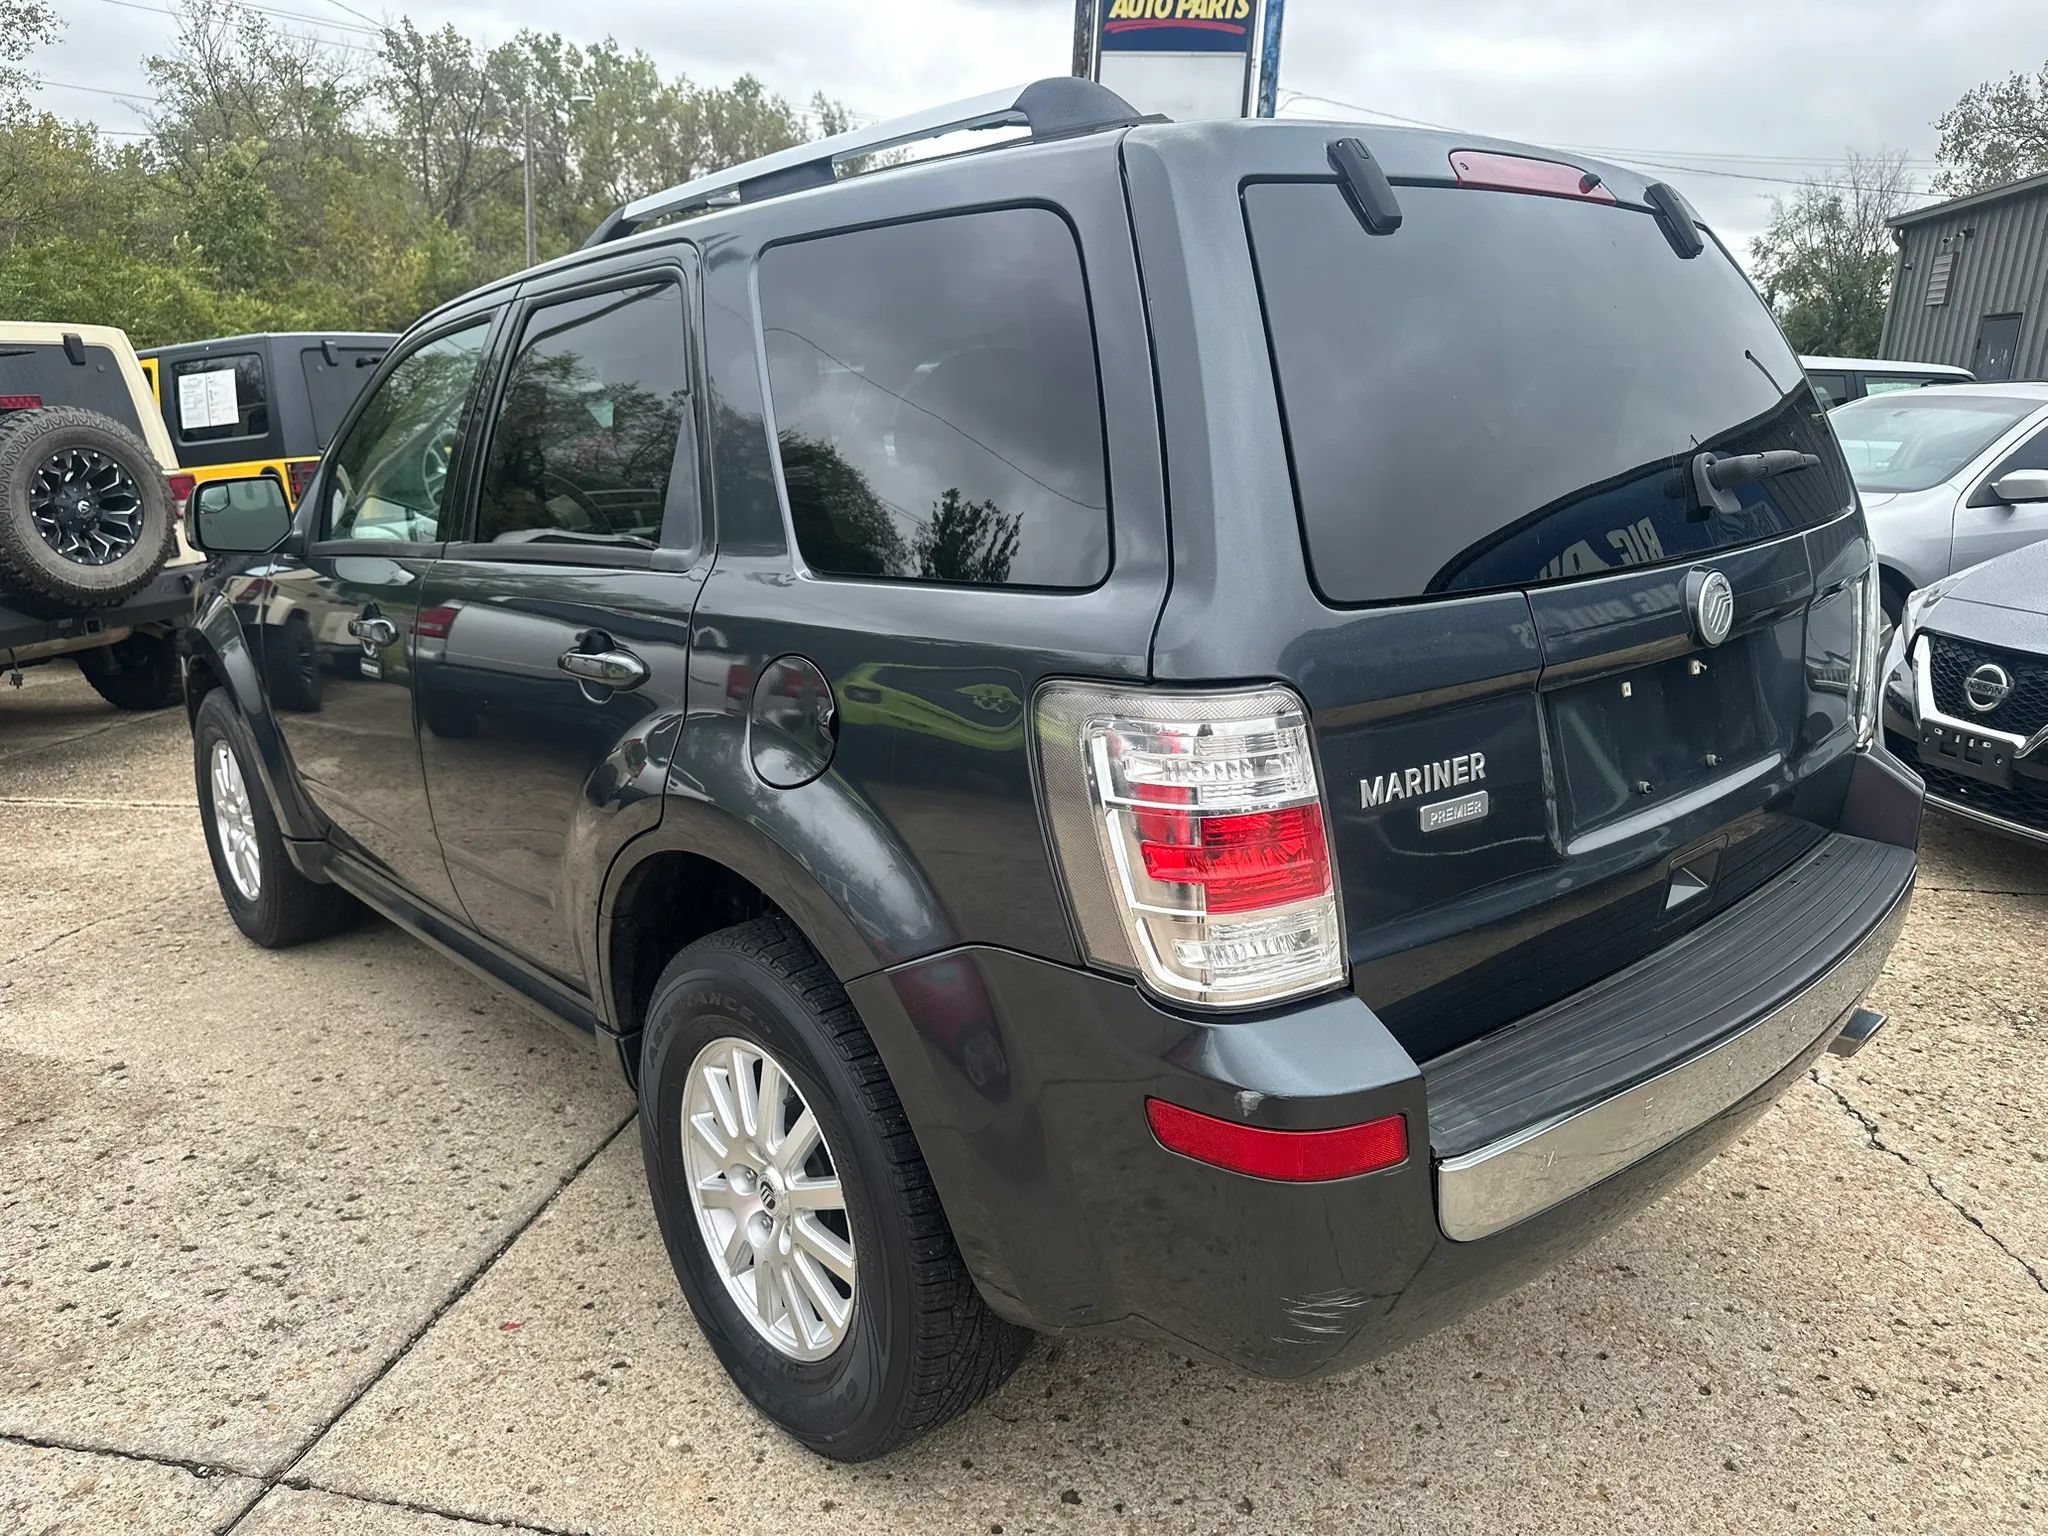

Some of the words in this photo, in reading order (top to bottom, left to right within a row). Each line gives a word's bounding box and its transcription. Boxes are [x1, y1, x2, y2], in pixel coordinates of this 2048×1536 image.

[1108, 0, 1173, 19] AUTO
[1175, 0, 1250, 19] PARTS
[1967, 679, 2004, 696] NISSAN
[1360, 752, 1487, 809] MARINER
[1430, 800, 1483, 826] PREMIER
